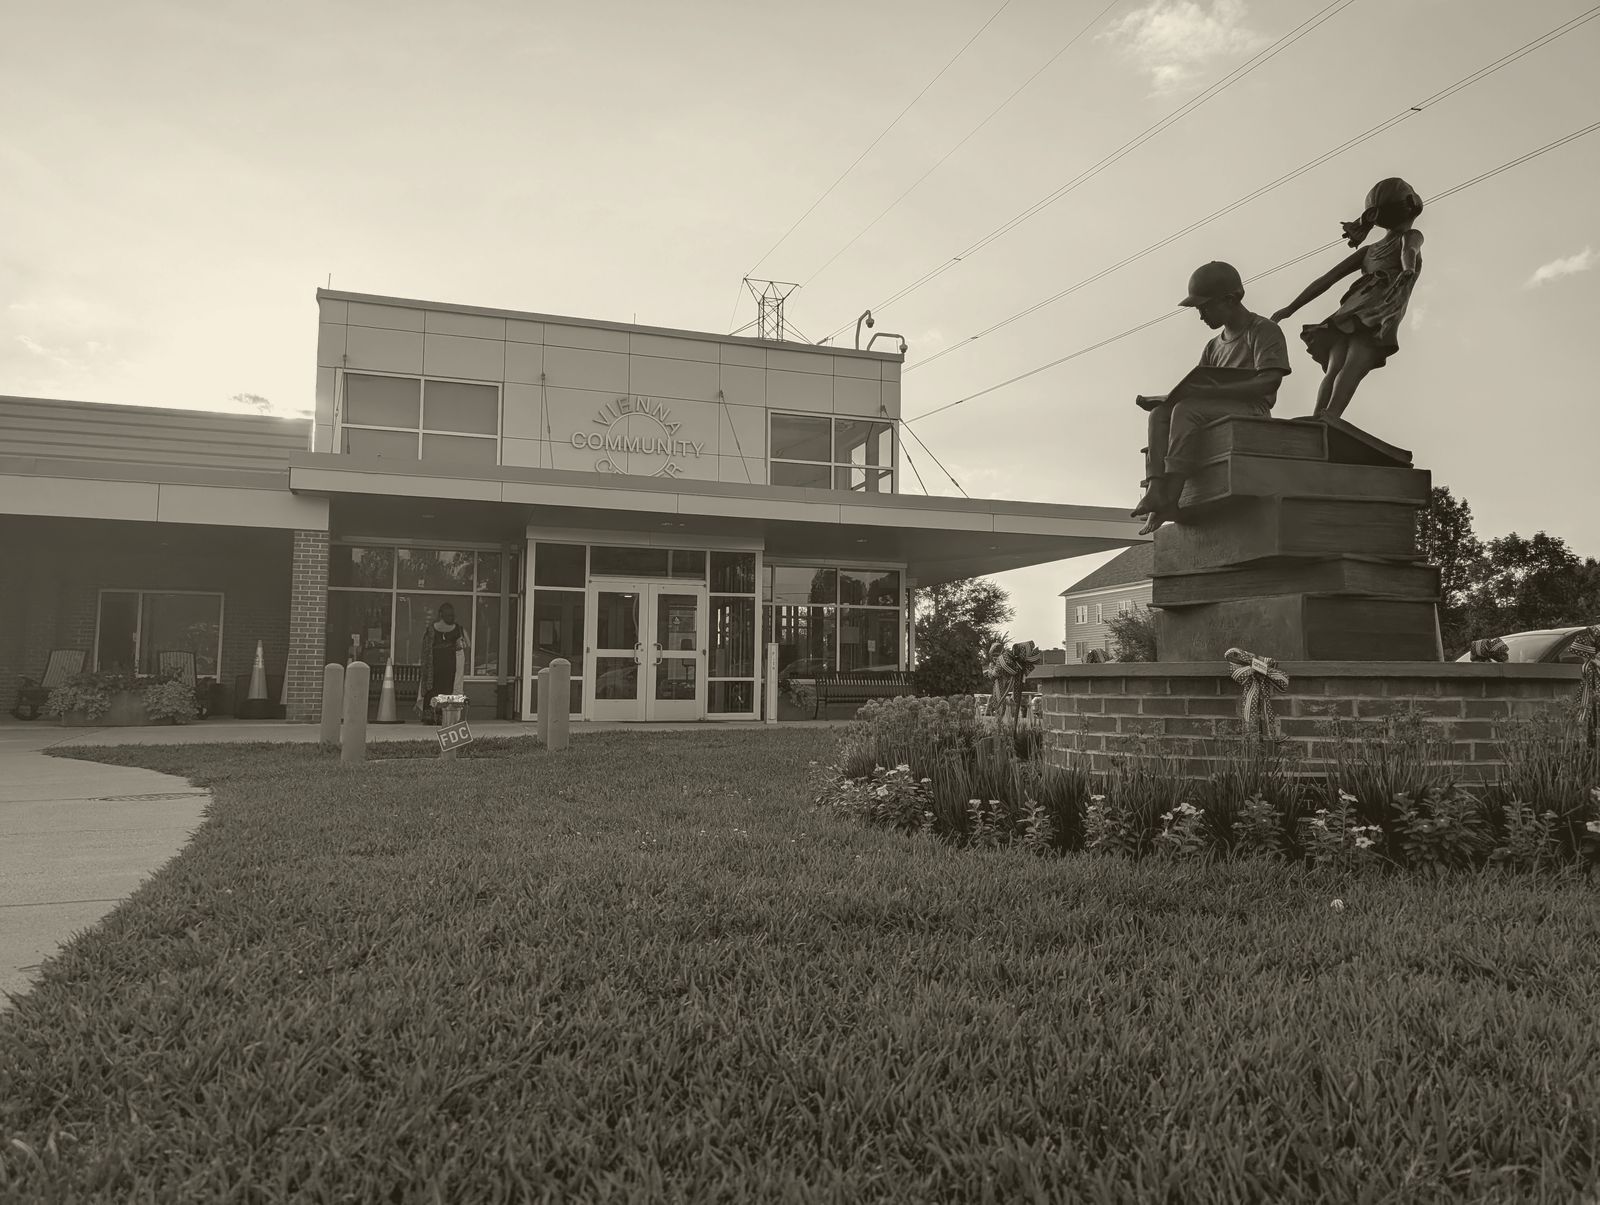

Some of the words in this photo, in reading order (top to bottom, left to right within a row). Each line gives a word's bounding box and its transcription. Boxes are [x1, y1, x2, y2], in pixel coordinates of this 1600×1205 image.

[592, 396, 682, 435] VIENNA
[571, 431, 705, 458] COMMUNITY
[440, 727, 469, 746] FDC
